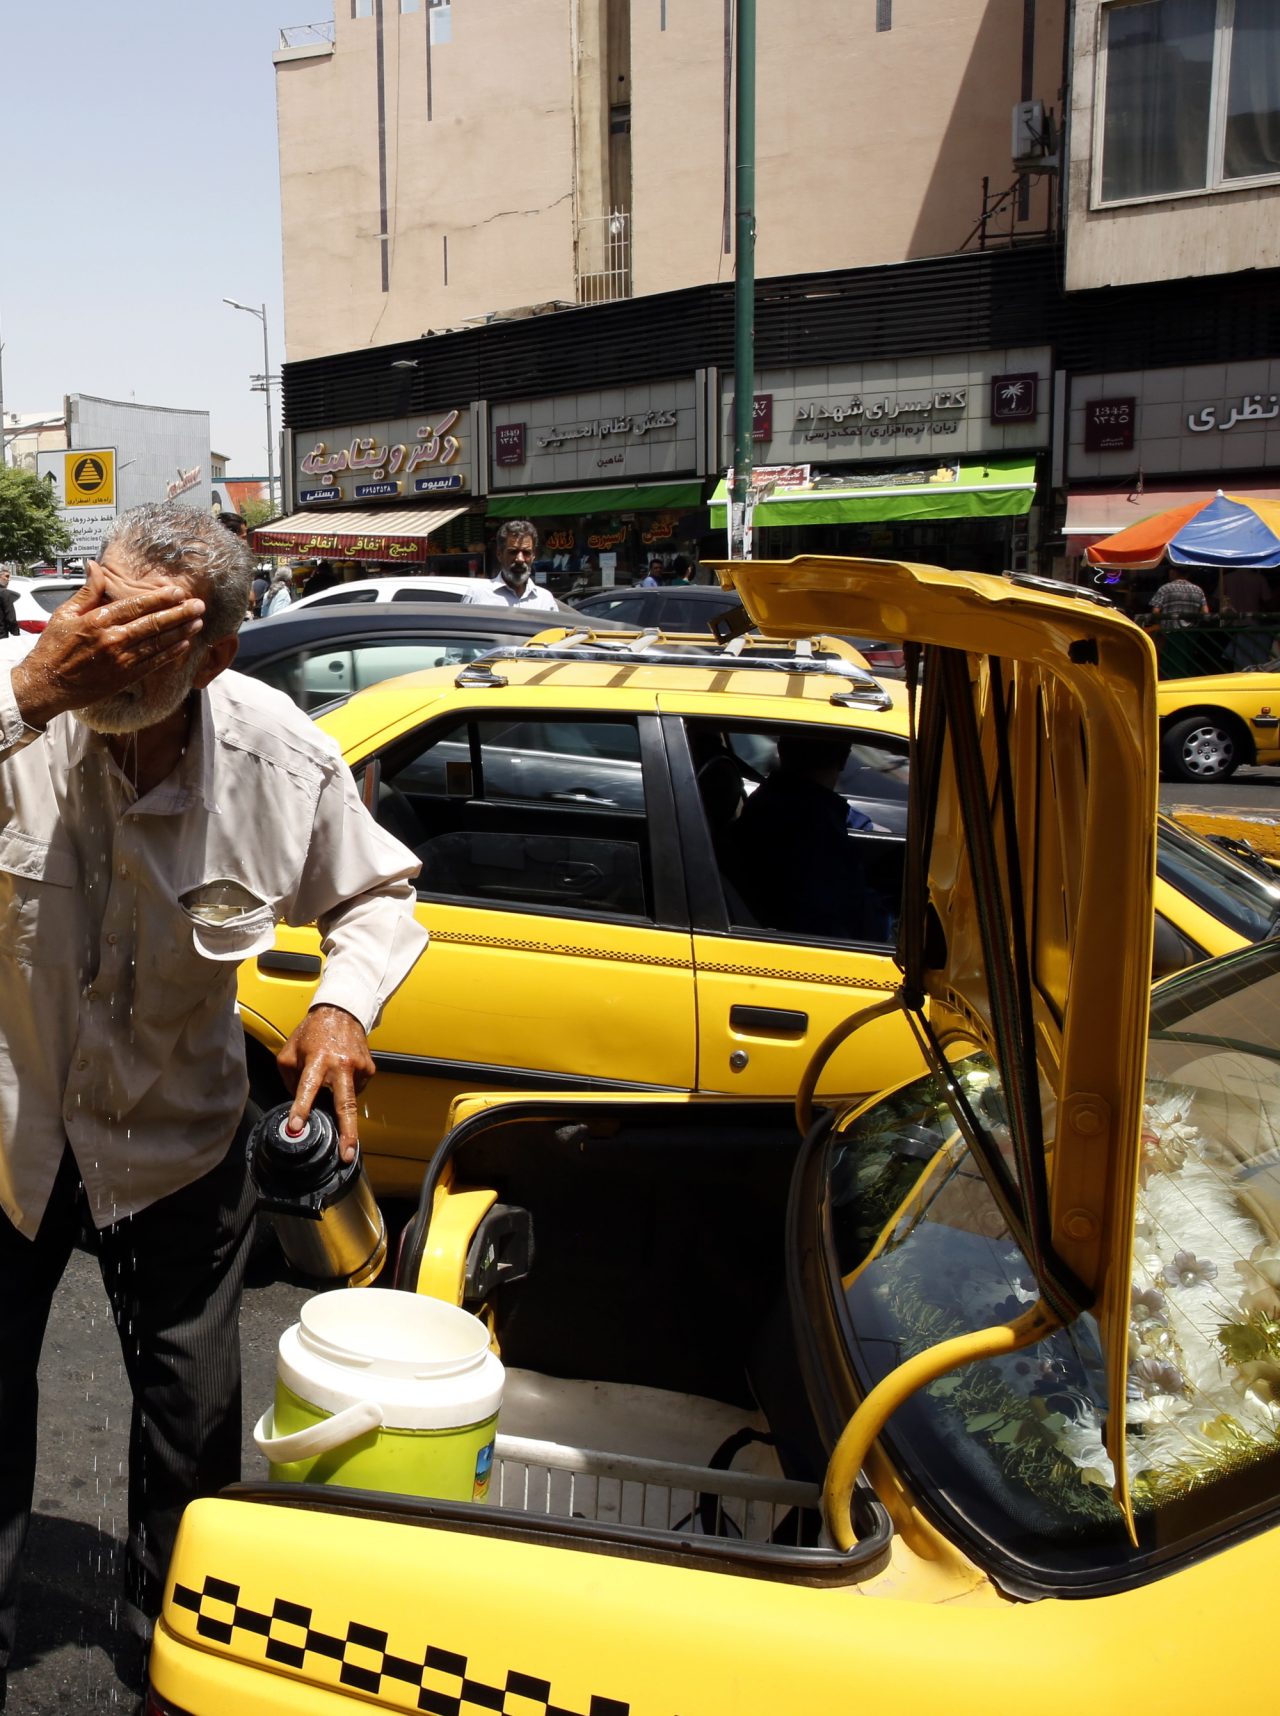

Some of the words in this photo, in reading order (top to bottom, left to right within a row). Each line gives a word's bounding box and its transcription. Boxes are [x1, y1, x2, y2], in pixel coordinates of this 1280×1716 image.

[864, 389, 966, 419] کتابسرای
[1095, 405, 1129, 416] 1345
[536, 419, 599, 448] الحسینی
[599, 414, 633, 439] نظام
[632, 410, 677, 436] کفش
[405, 410, 459, 473] دکتر
[300, 438, 407, 485] ویتامینه
[597, 454, 624, 468] شاهین
[306, 490, 335, 502] بستنی
[261, 535, 296, 551] نیست
[344, 537, 386, 555] اتفاقی
[388, 542, 418, 557] هیچ
